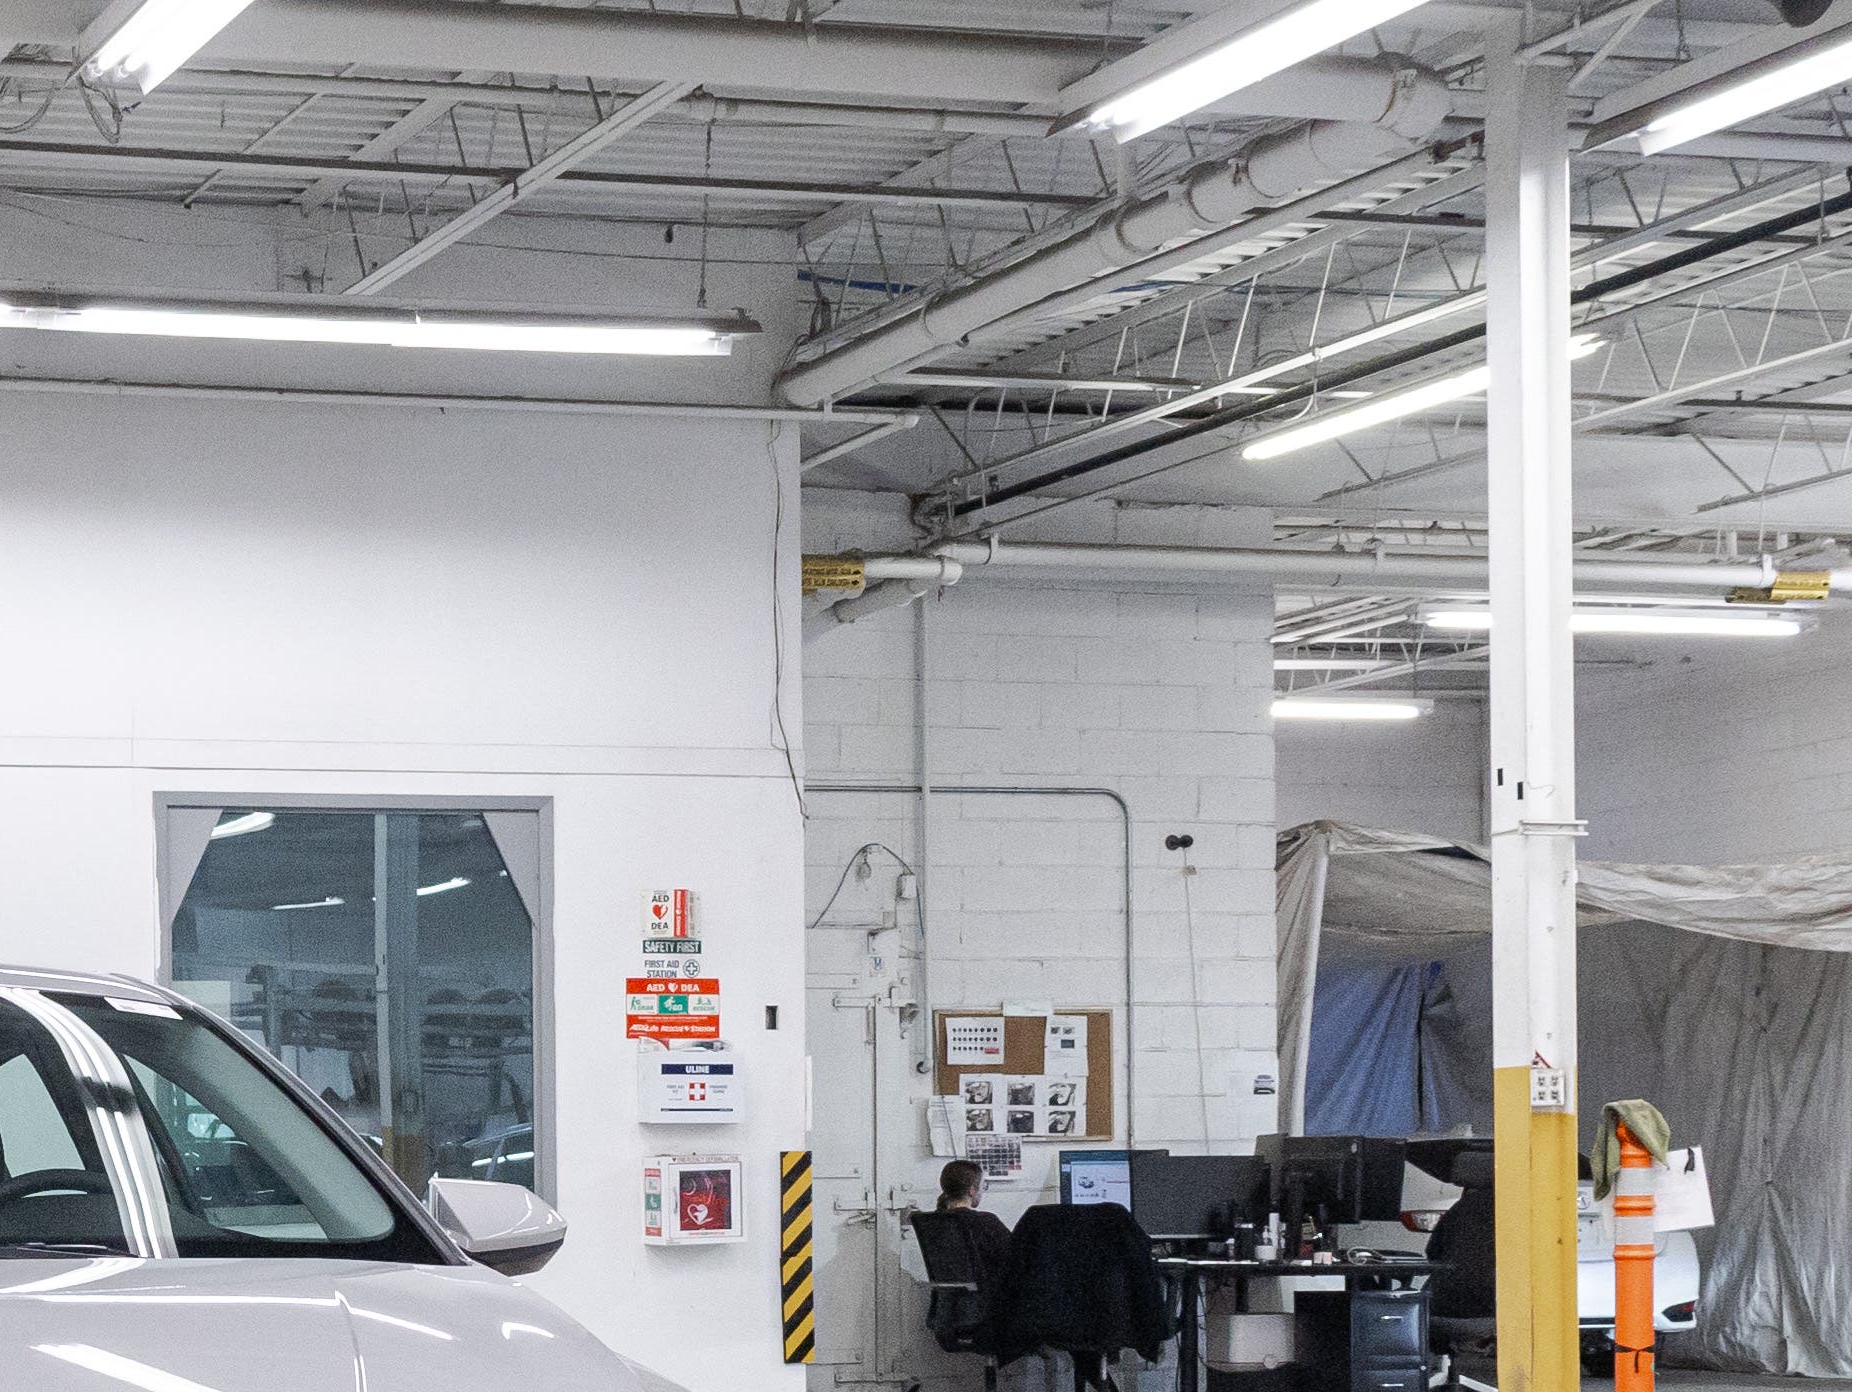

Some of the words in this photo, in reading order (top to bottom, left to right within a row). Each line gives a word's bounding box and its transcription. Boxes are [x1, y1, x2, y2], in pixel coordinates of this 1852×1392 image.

[651, 895, 670, 903] AED
[651, 922, 669, 930] DEA
[644, 941, 676, 953] SAFETY
[676, 941, 700, 953] FIRST
[644, 960, 665, 968] FIRST
[666, 960, 680, 968] AID
[646, 970, 677, 978] STATION
[646, 983, 666, 992] AED
[680, 983, 700, 992] DEA
[685, 1065, 710, 1074] ULINE
